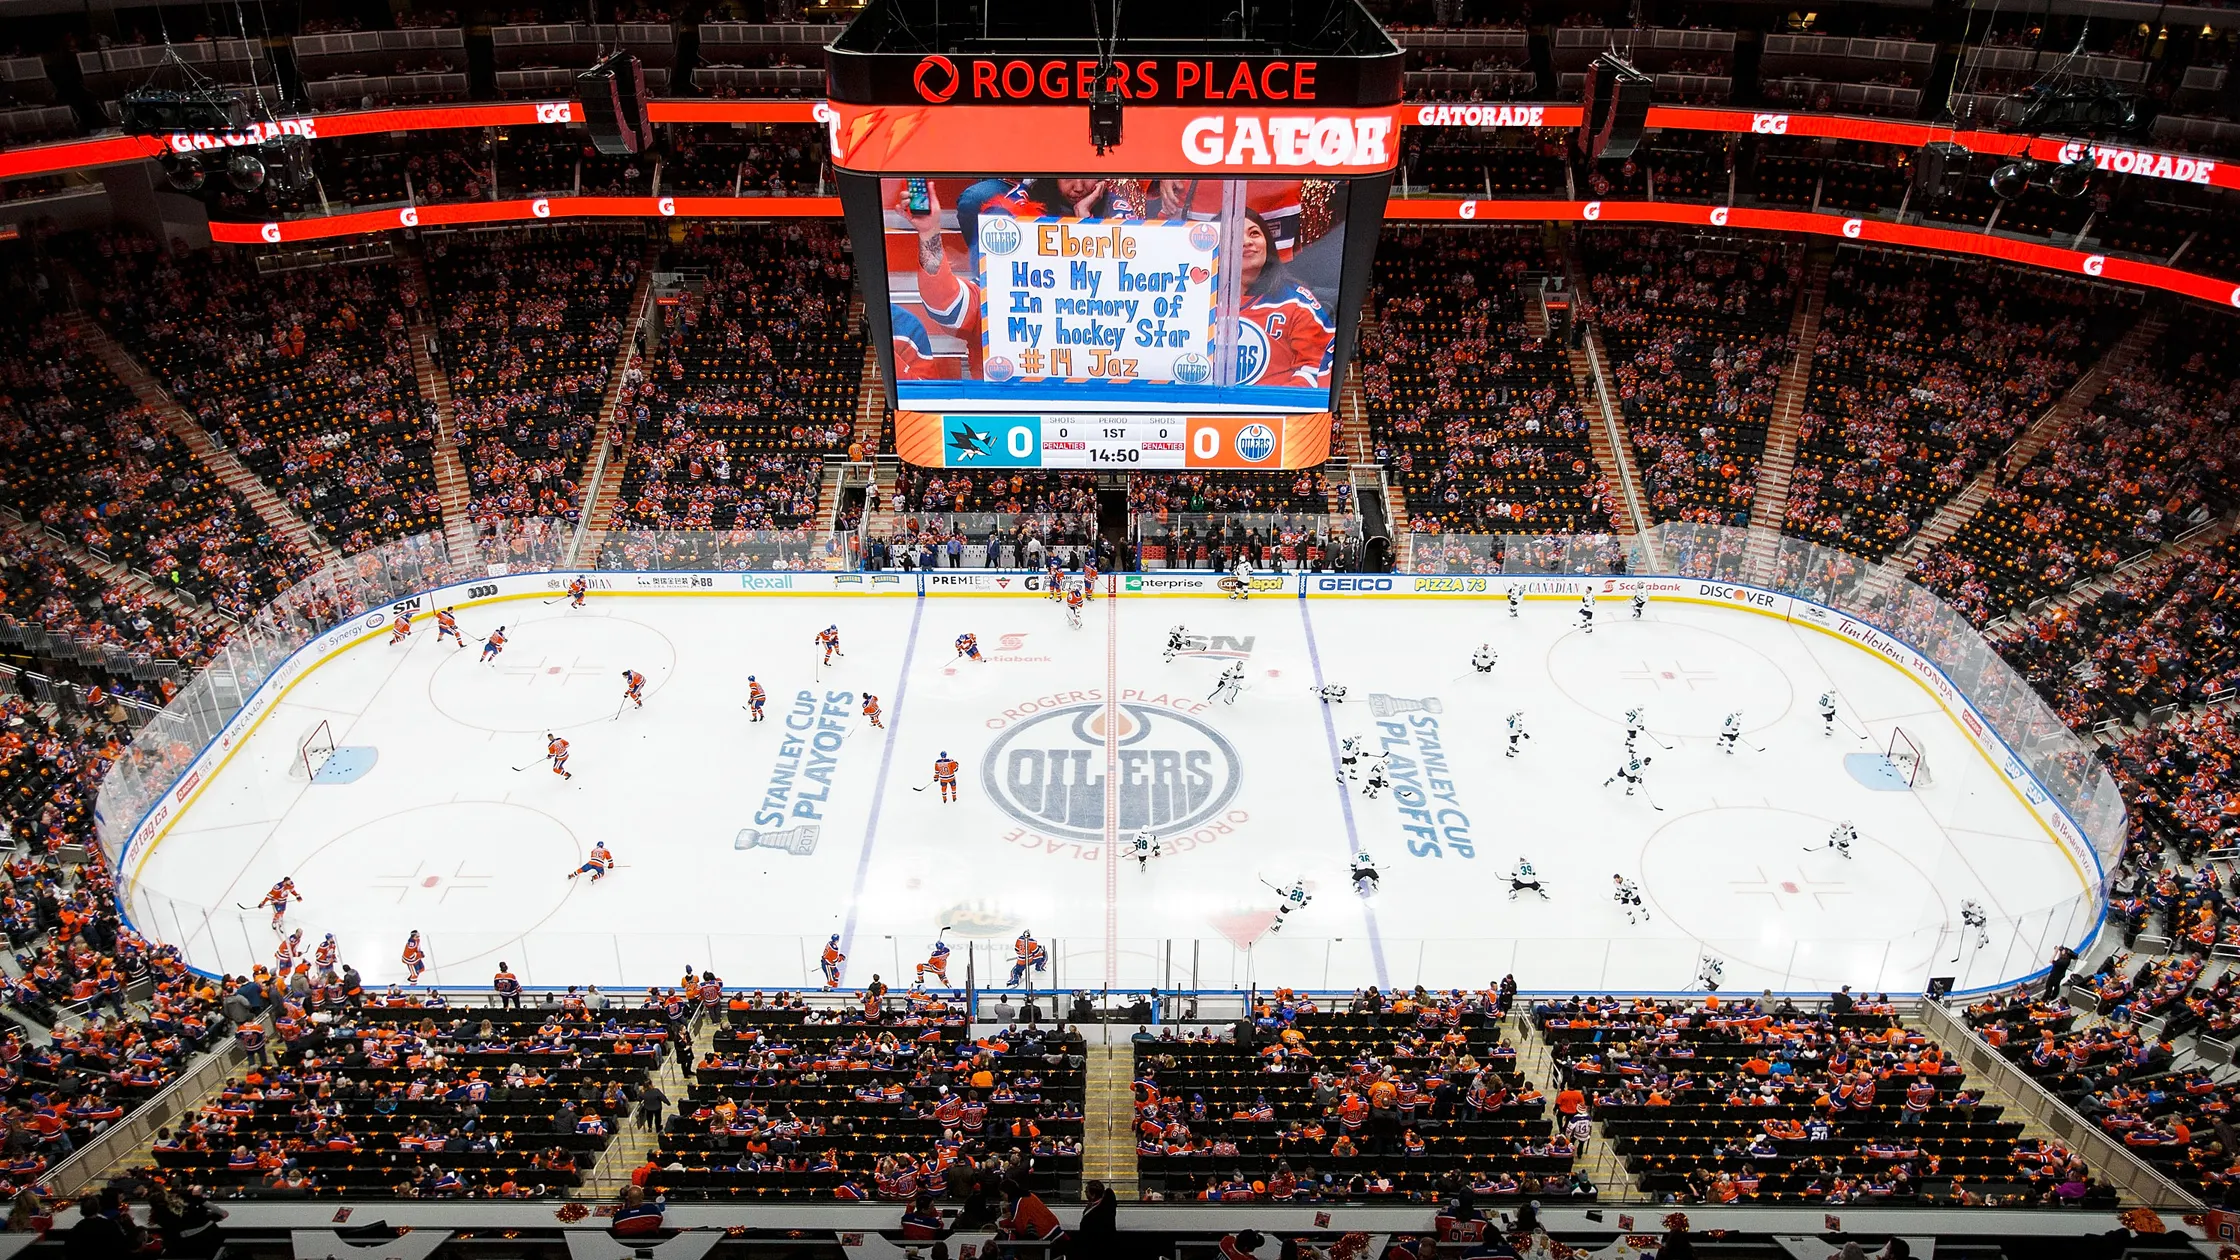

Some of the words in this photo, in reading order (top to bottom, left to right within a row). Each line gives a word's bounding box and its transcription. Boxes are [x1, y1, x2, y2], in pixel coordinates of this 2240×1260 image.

[973, 60, 1158, 99] ROGERS
[1176, 61, 1316, 99] PLACE
[1417, 107, 1544, 127] GATORADE
[171, 119, 317, 152] GATORADE
[2058, 143, 2214, 184] GATORADE
[400, 207, 419, 226] G
[533, 199, 551, 218] G
[658, 198, 676, 216] G
[1458, 200, 1476, 219] G
[1582, 201, 1601, 220] G
[1710, 206, 1729, 225] G
[261, 222, 281, 243] G
[1843, 218, 1862, 238] G
[985, 231, 1017, 252] OILERS
[1038, 224, 1136, 259] Eberle
[2083, 255, 2105, 276] G
[1011, 261, 1056, 289] Has
[1070, 260, 1101, 298] My
[1118, 261, 1190, 292] heart
[1009, 291, 1042, 314] In
[1055, 296, 1139, 323] memory
[1007, 316, 1042, 348] My
[1056, 317, 1125, 351] hockey
[1134, 318, 1190, 348] Star
[1265, 312, 1286, 341] C
[1088, 349, 1139, 377] Jaz
[1177, 362, 1207, 381] OILERS
[1007, 425, 1033, 459] 0
[1059, 427, 1068, 438] 0
[1102, 428, 1126, 439] 1ST
[1159, 428, 1168, 439] 0
[1043, 442, 1085, 450] PENALTIES
[1142, 442, 1184, 450] PENALTIES
[1193, 427, 1220, 459] 0
[1240, 438, 1270, 459] OILERS
[1089, 448, 1140, 463] 14:50
[562, 579, 612, 591] CDIAN
[700, 577, 713, 587] 88
[742, 574, 793, 589] Rexall
[837, 575, 861, 583] PLANTERS
[874, 575, 898, 583] PLANTERS
[933, 576, 990, 585] PREMIER
[1024, 576, 1039, 591] G
[1131, 579, 1203, 589] enterprise
[1318, 578, 1393, 591] GEICO
[1415, 579, 1463, 591] PIZZA
[1467, 579, 1487, 591] 73
[1529, 582, 1580, 593] CANADIAN
[1700, 584, 1775, 608] DISCOVER
[393, 597, 421, 615] SN
[368, 614, 383, 626] Esso
[328, 622, 364, 646] Synergy
[1838, 617, 1861, 640] Tim
[1861, 629, 1905, 665] Hortons
[1912, 657, 1953, 701] HONDA
[241, 698, 264, 729] CANADA
[1001, 689, 1103, 720] ROGERS
[1122, 688, 1209, 716] PLACE
[1373, 694, 1385, 715] 2017
[753, 732, 806, 829] STANLEY
[785, 689, 818, 731] CUP
[791, 690, 855, 822] PLAYOFFS
[2005, 758, 2020, 779] SAP
[1007, 748, 1213, 831] OILERS
[1375, 720, 1443, 860] PLAYOFFS
[1408, 714, 1460, 808] STANLEY
[1436, 808, 1476, 860] CUP
[2026, 783, 2043, 804] SAP
[798, 828, 816, 853] 2017
[1002, 826, 1101, 862] PLACE
[1121, 822, 1236, 862] ROGES
[1136, 837, 1148, 850] 38
[1357, 854, 1370, 863] 36
[1522, 865, 1534, 876] 39
[1289, 889, 1303, 903] 28
[470, 1088, 486, 1101] 97
[1578, 1125, 1587, 1133] 14
[1811, 1131, 1828, 1141] 20
[1449, 1229, 1477, 1243] 97
